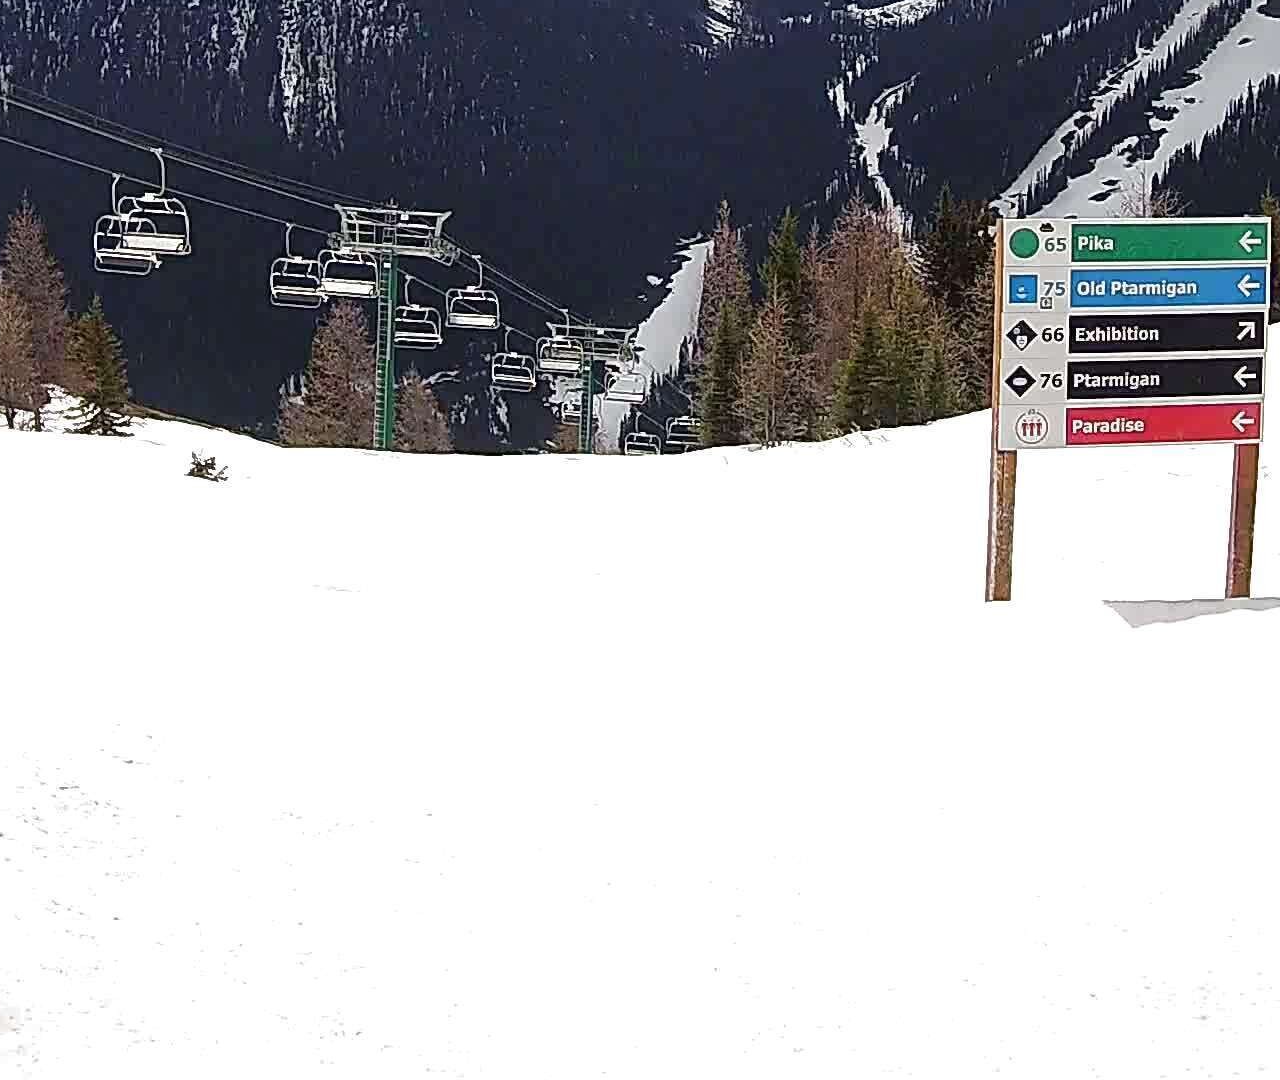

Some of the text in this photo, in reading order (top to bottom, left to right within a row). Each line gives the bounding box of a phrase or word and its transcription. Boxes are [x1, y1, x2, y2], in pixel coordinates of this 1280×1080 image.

[1044, 235, 1114, 252] 65 Pika
[1043, 279, 1197, 298] 75 Old Ptarmigan
[1041, 325, 1160, 343] 66 Exhibition
[1040, 371, 1161, 390] 76 Ptarmigan
[1072, 417, 1145, 434] Paradise
